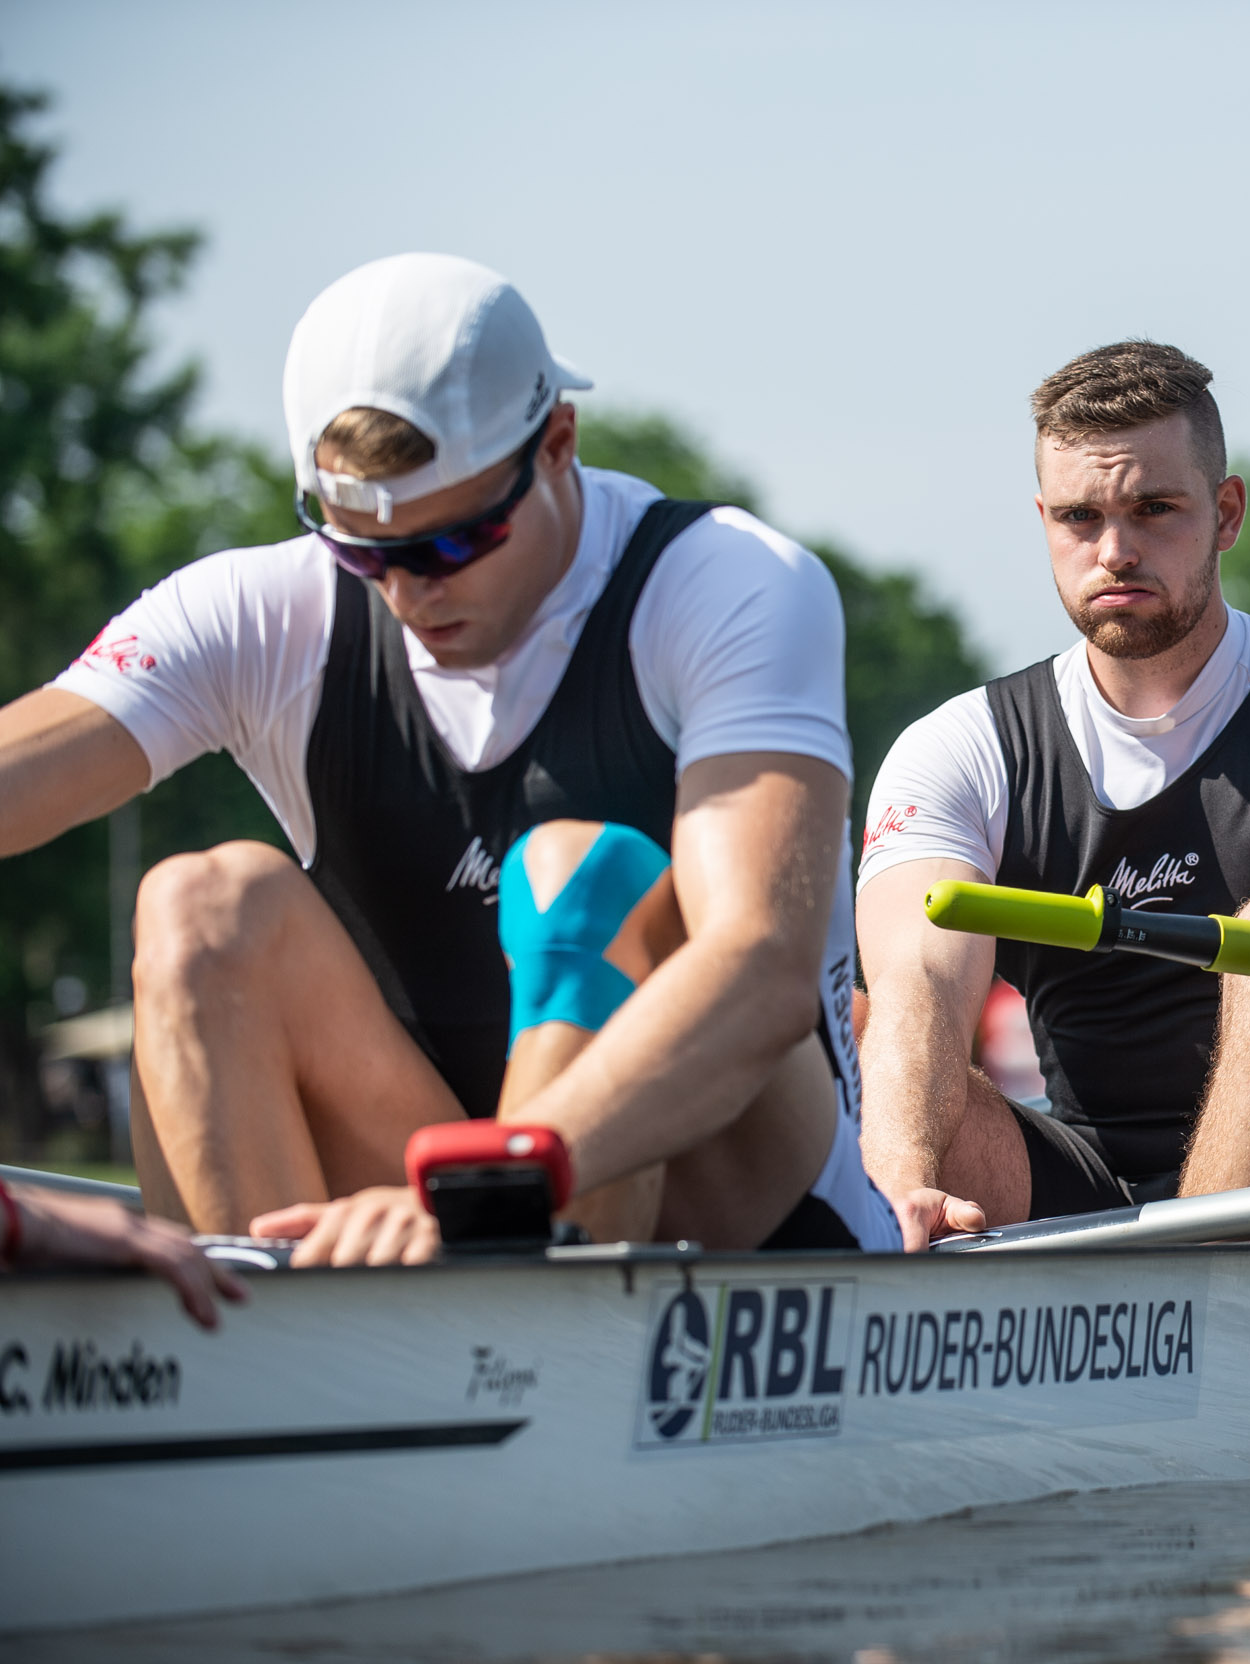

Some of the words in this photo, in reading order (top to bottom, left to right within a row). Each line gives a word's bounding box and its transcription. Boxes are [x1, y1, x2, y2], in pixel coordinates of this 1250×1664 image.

[41, 1337, 181, 1412] Minden
[719, 1286, 844, 1400] RBL
[858, 1300, 1194, 1397] RUDER-BUNDESLIGA
